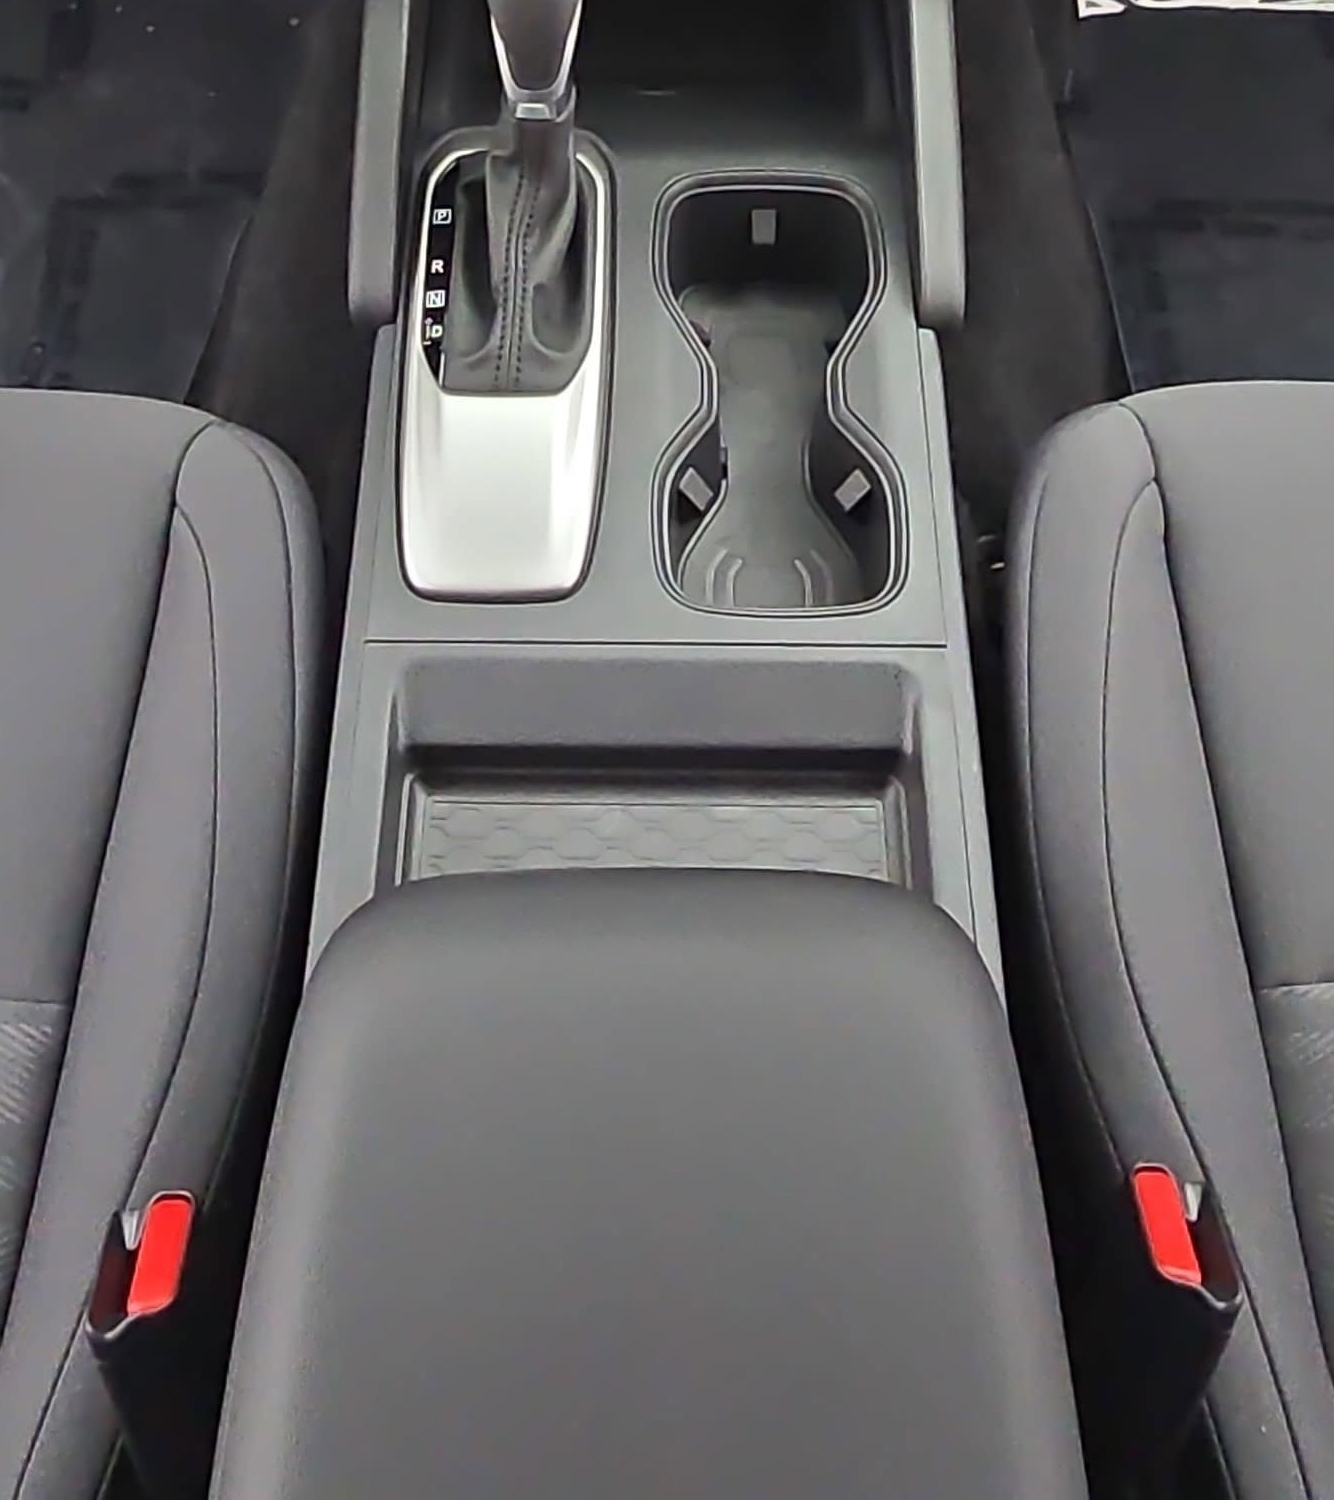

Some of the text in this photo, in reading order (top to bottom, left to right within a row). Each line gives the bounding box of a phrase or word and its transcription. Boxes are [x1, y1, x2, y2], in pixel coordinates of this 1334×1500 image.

[435, 210, 449, 223] P
[430, 259, 444, 273] R
[428, 291, 444, 306] N
[431, 324, 443, 338] D
